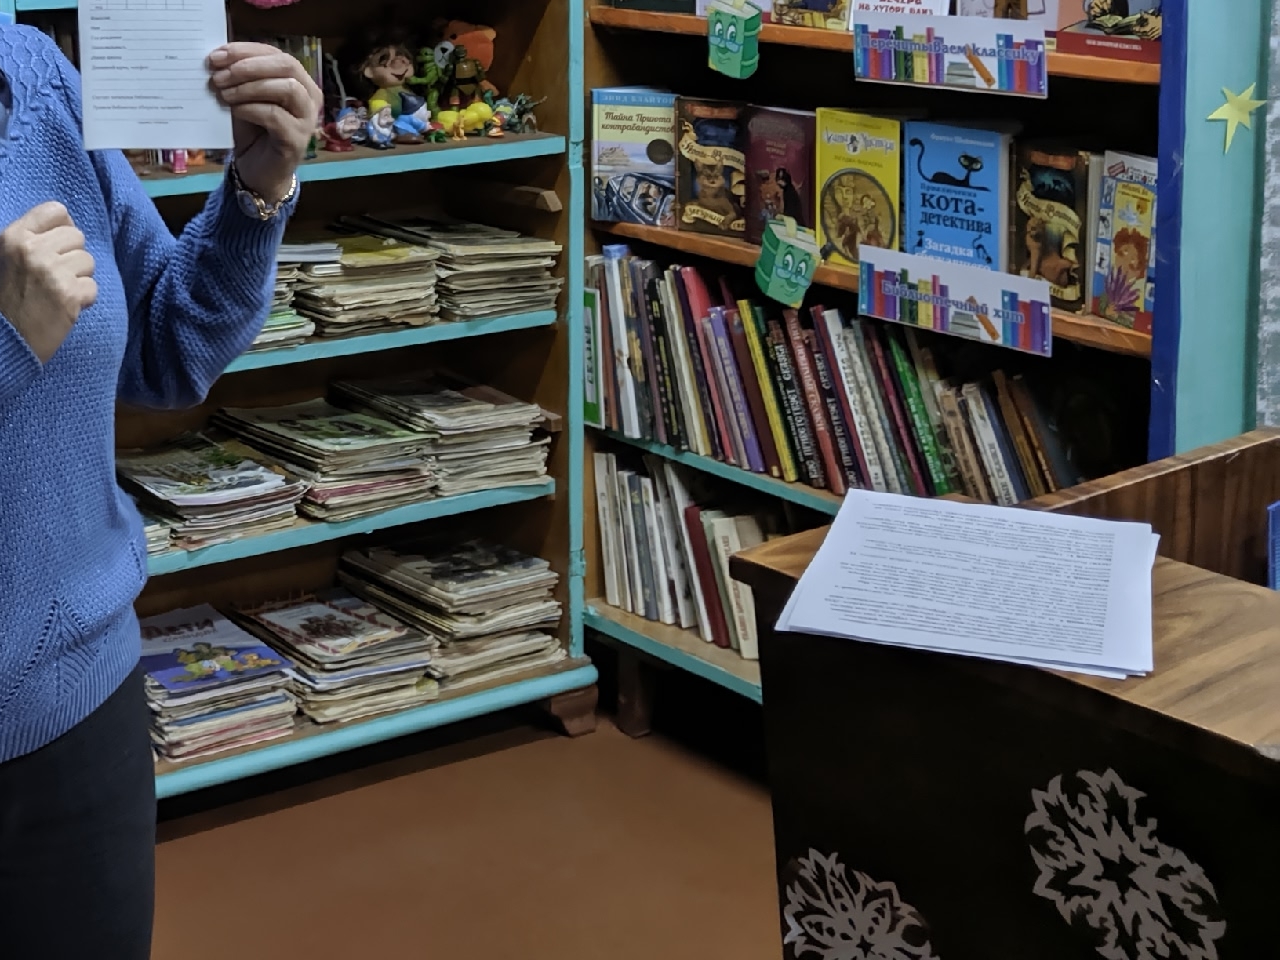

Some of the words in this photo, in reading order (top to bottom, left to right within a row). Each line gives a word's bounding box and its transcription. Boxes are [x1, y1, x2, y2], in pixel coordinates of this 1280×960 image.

[860, 34, 966, 56] Перечитываем
[972, 43, 1040, 65] классику
[601, 123, 675, 135] контрабандистов
[604, 112, 633, 122] Тайна
[636, 113, 671, 123] Приюта
[920, 183, 977, 197] Приключения
[920, 193, 984, 216] кота-
[920, 211, 992, 235] детектива
[924, 237, 973, 257] Загадка
[881, 280, 989, 316] Библиотечный
[993, 308, 1025, 323] хит
[773, 343, 793, 381] СКАЗКА
[812, 350, 831, 390] СКАЗКА
